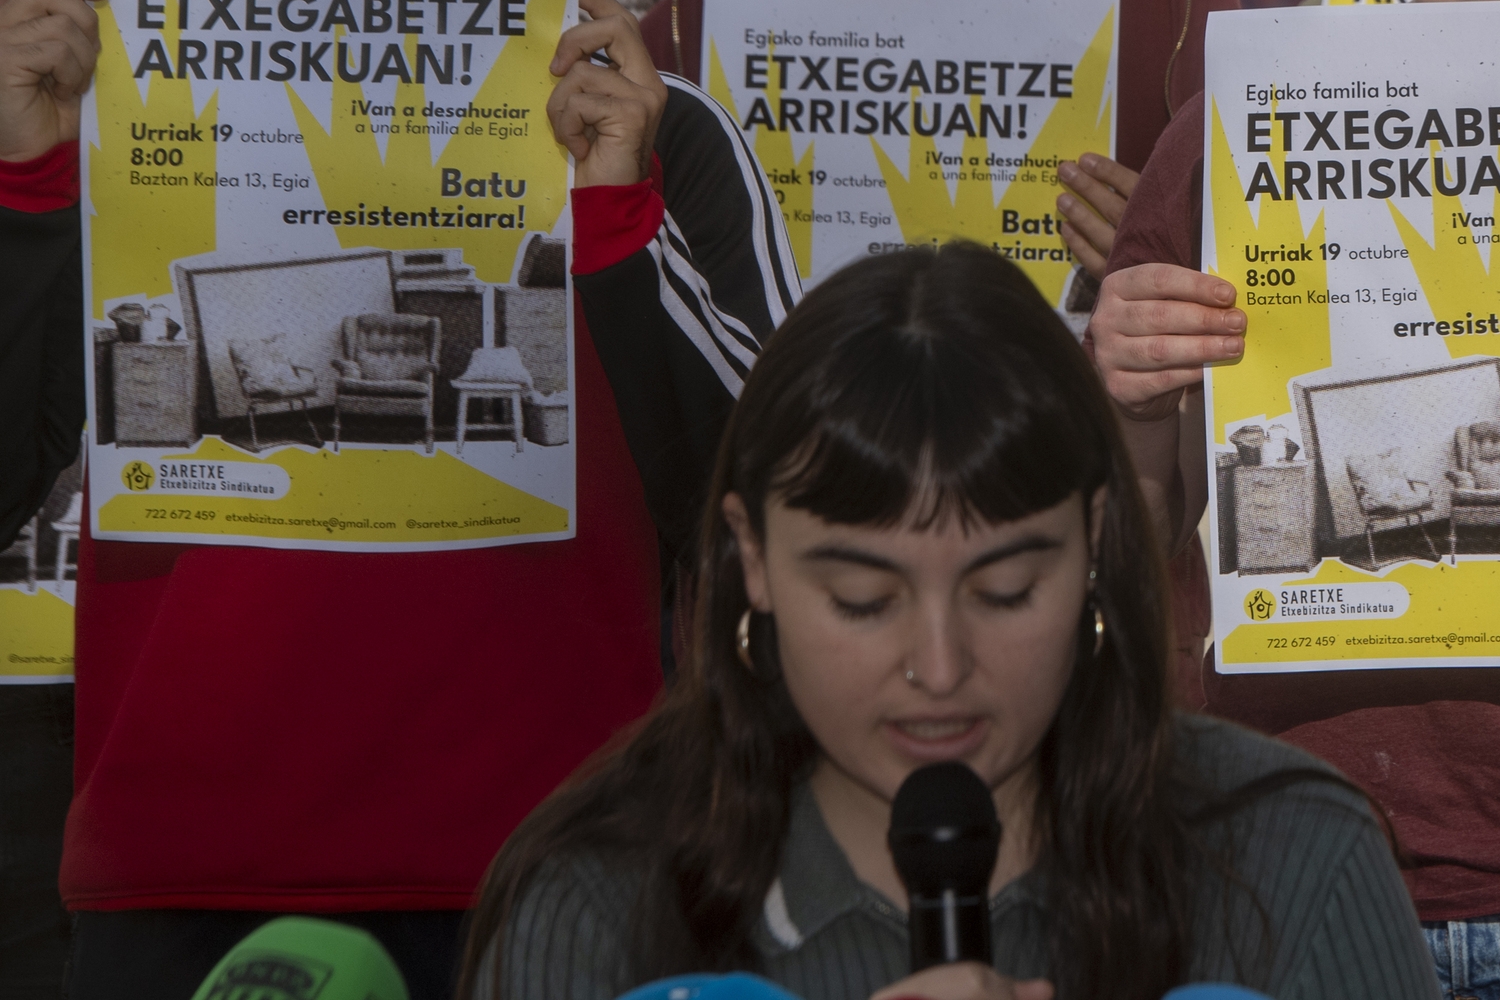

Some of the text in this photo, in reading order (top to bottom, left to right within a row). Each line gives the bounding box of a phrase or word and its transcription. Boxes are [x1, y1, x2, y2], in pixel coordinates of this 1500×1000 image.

[744, 28, 905, 49] Egiako familia bat
[133, 38, 473, 86] ARRISKUAN!
[745, 53, 1073, 99] ETXEGABETZE
[1246, 80, 1419, 107] Egiako familia bat
[351, 99, 530, 119] ¡Van a desahuciar
[742, 97, 1028, 140] ARRISKUAN!
[131, 122, 305, 144] Urriak 19 octubre
[354, 119, 529, 141] a una familia de Egia!
[130, 147, 184, 167] 8:00
[925, 151, 964, 166] ¡Van
[968, 156, 980, 166] a
[130, 170, 310, 193] Baztan Kalea 13, Egia
[441, 167, 526, 199] Batu
[808, 169, 828, 186] 19
[832, 174, 887, 188] octubre
[928, 171, 939, 180] a
[941, 171, 968, 181] una
[970, 168, 1017, 182] familia
[1020, 170, 1038, 183] de
[283, 204, 525, 229] erresistentziara!
[793, 209, 833, 223] Kalea
[836, 210, 856, 225] 13,
[859, 211, 892, 228] Egia
[1451, 211, 1496, 229] ¡Van
[1457, 235, 1467, 245] a
[1471, 234, 1500, 245] una
[1245, 242, 1409, 263] Urriak 19 octubre
[1246, 268, 1296, 287] 8:00
[1246, 287, 1418, 306] Baztan Kalea 13, Egia
[159, 463, 224, 480] SARETXE
[159, 478, 275, 495] Etxebizitza Sindikatua
[145, 508, 167, 520] 722
[169, 509, 192, 520] 672
[194, 510, 216, 521] 459
[1280, 588, 1344, 605] SARETXE
[1281, 602, 1394, 617] Etxebizitza Sindikatua
[1267, 637, 1288, 649] 722
[1290, 636, 1312, 648] 672
[1314, 635, 1336, 647] 459
